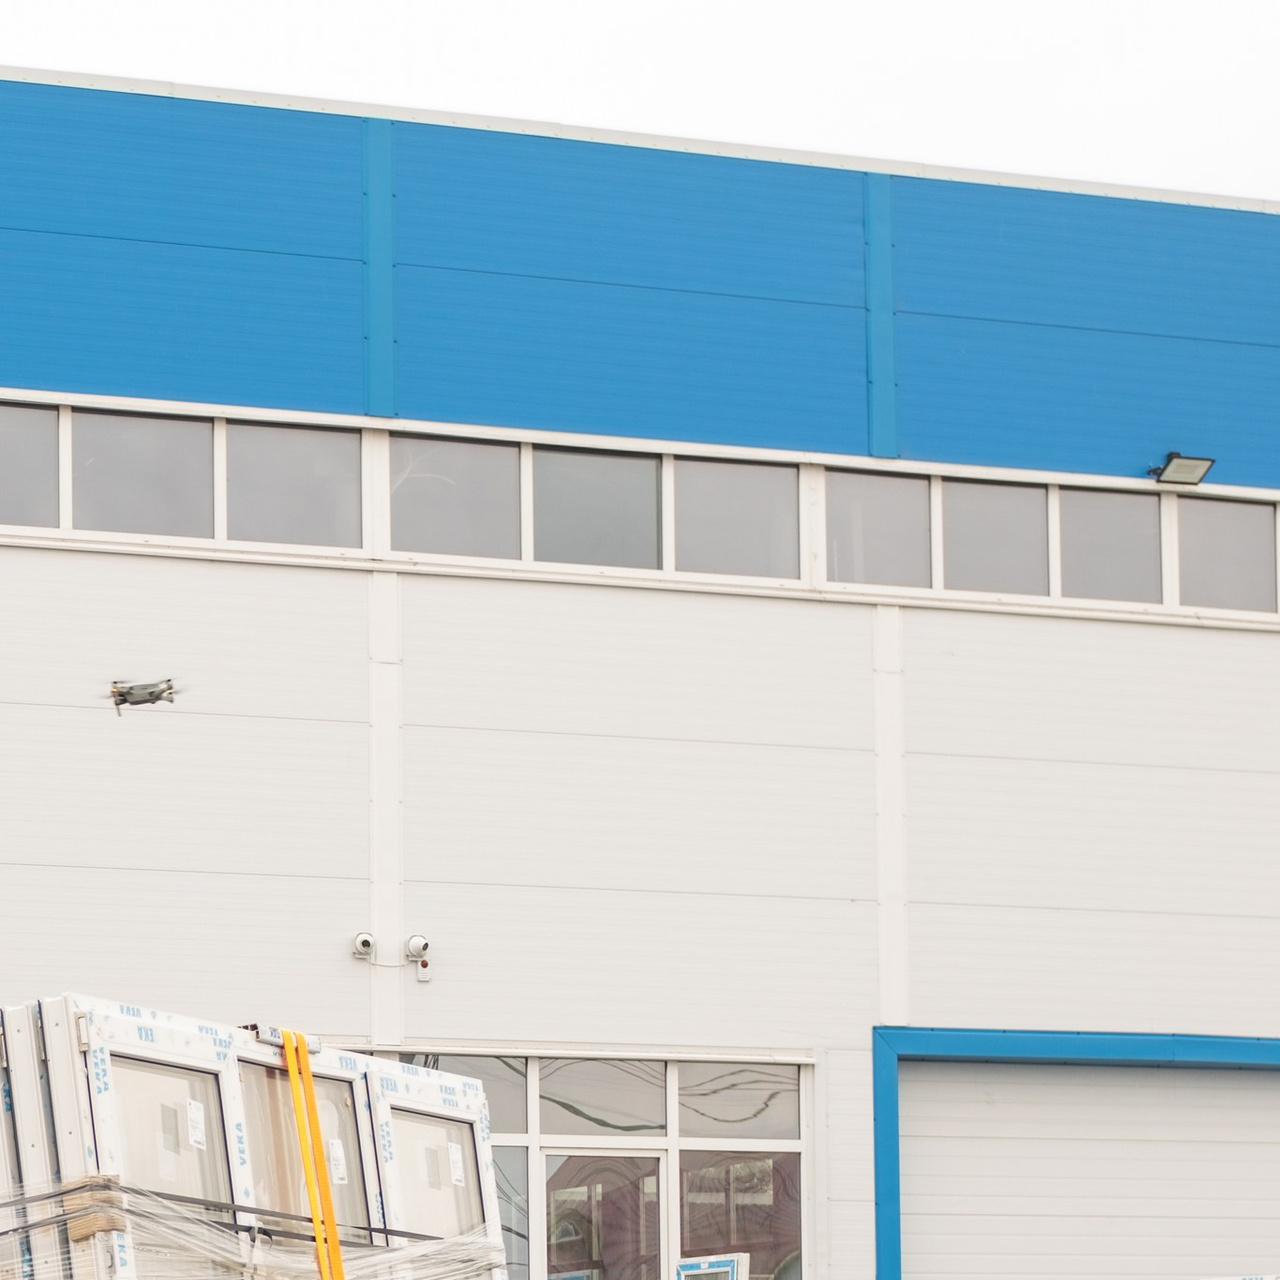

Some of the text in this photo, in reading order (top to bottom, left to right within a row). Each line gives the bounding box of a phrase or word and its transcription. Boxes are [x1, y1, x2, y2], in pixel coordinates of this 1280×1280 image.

[137, 1025, 155, 1042] EKA
[235, 1122, 248, 1166] VEKA
[116, 1233, 127, 1267] EKA
